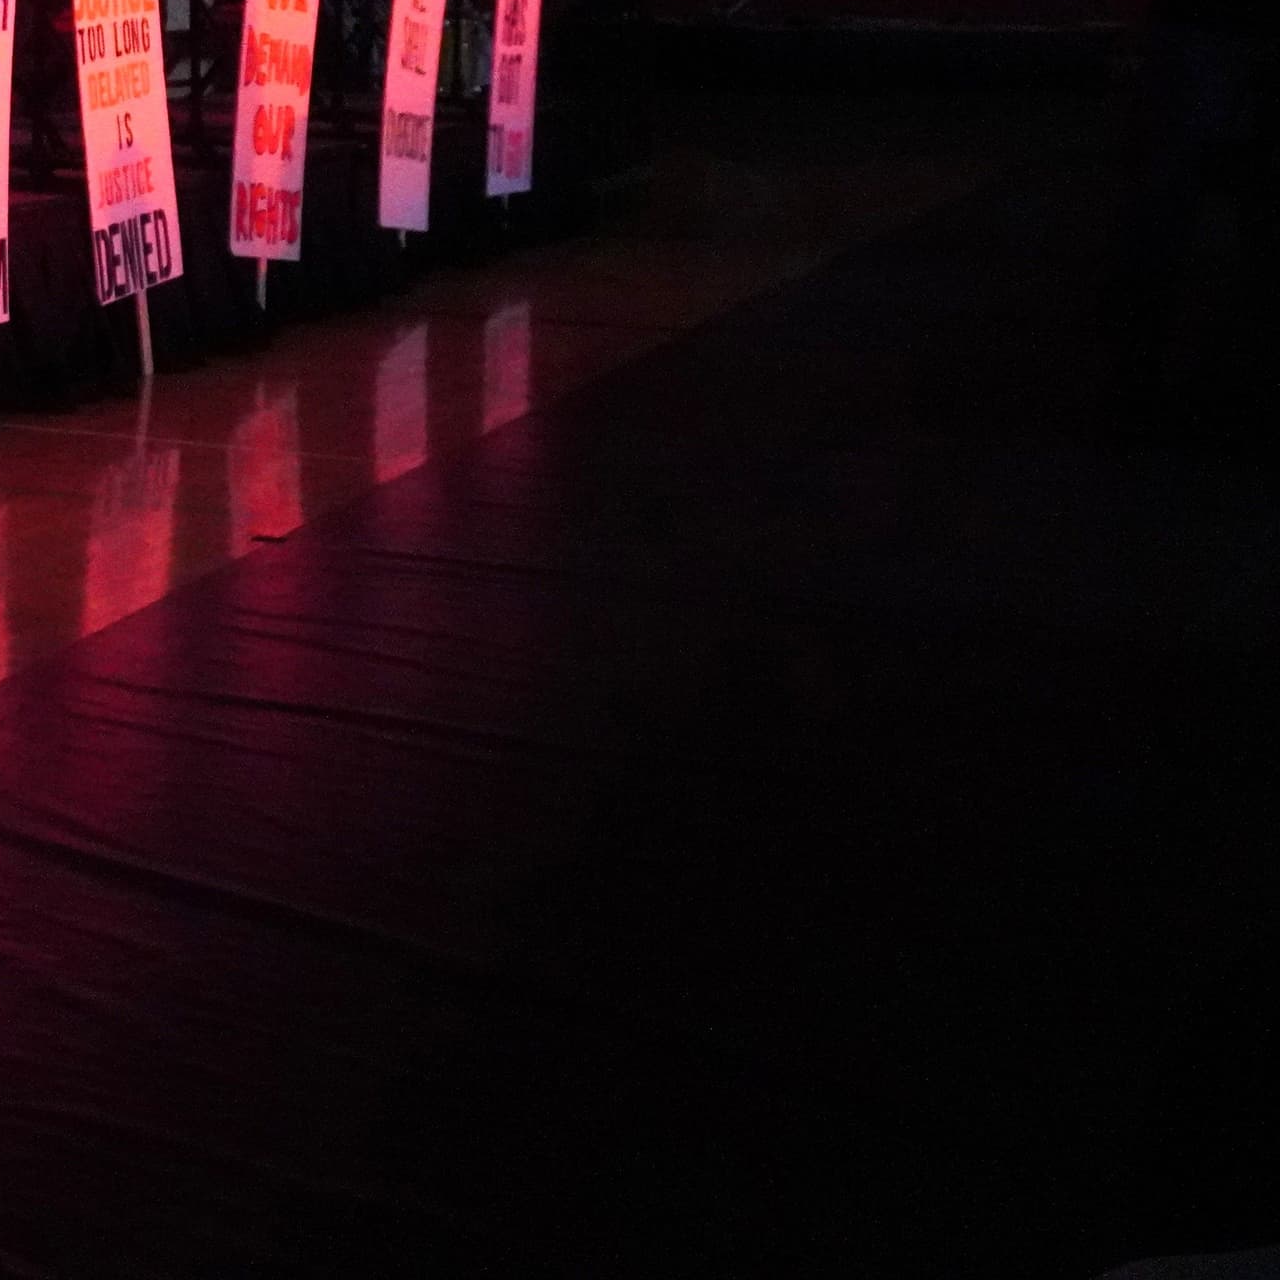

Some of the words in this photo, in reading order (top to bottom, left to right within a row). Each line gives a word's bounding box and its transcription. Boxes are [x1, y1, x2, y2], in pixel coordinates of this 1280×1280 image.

[78, 25, 104, 63] TOO
[115, 18, 150, 57] LONG
[243, 25, 311, 95] DEMAND
[89, 62, 149, 110] DELAYED
[117, 113, 133, 149] IS
[252, 105, 295, 159] OUR
[97, 158, 152, 208] JUSTICE
[235, 182, 301, 243] RIGHTS
[94, 210, 171, 301] DENIED
